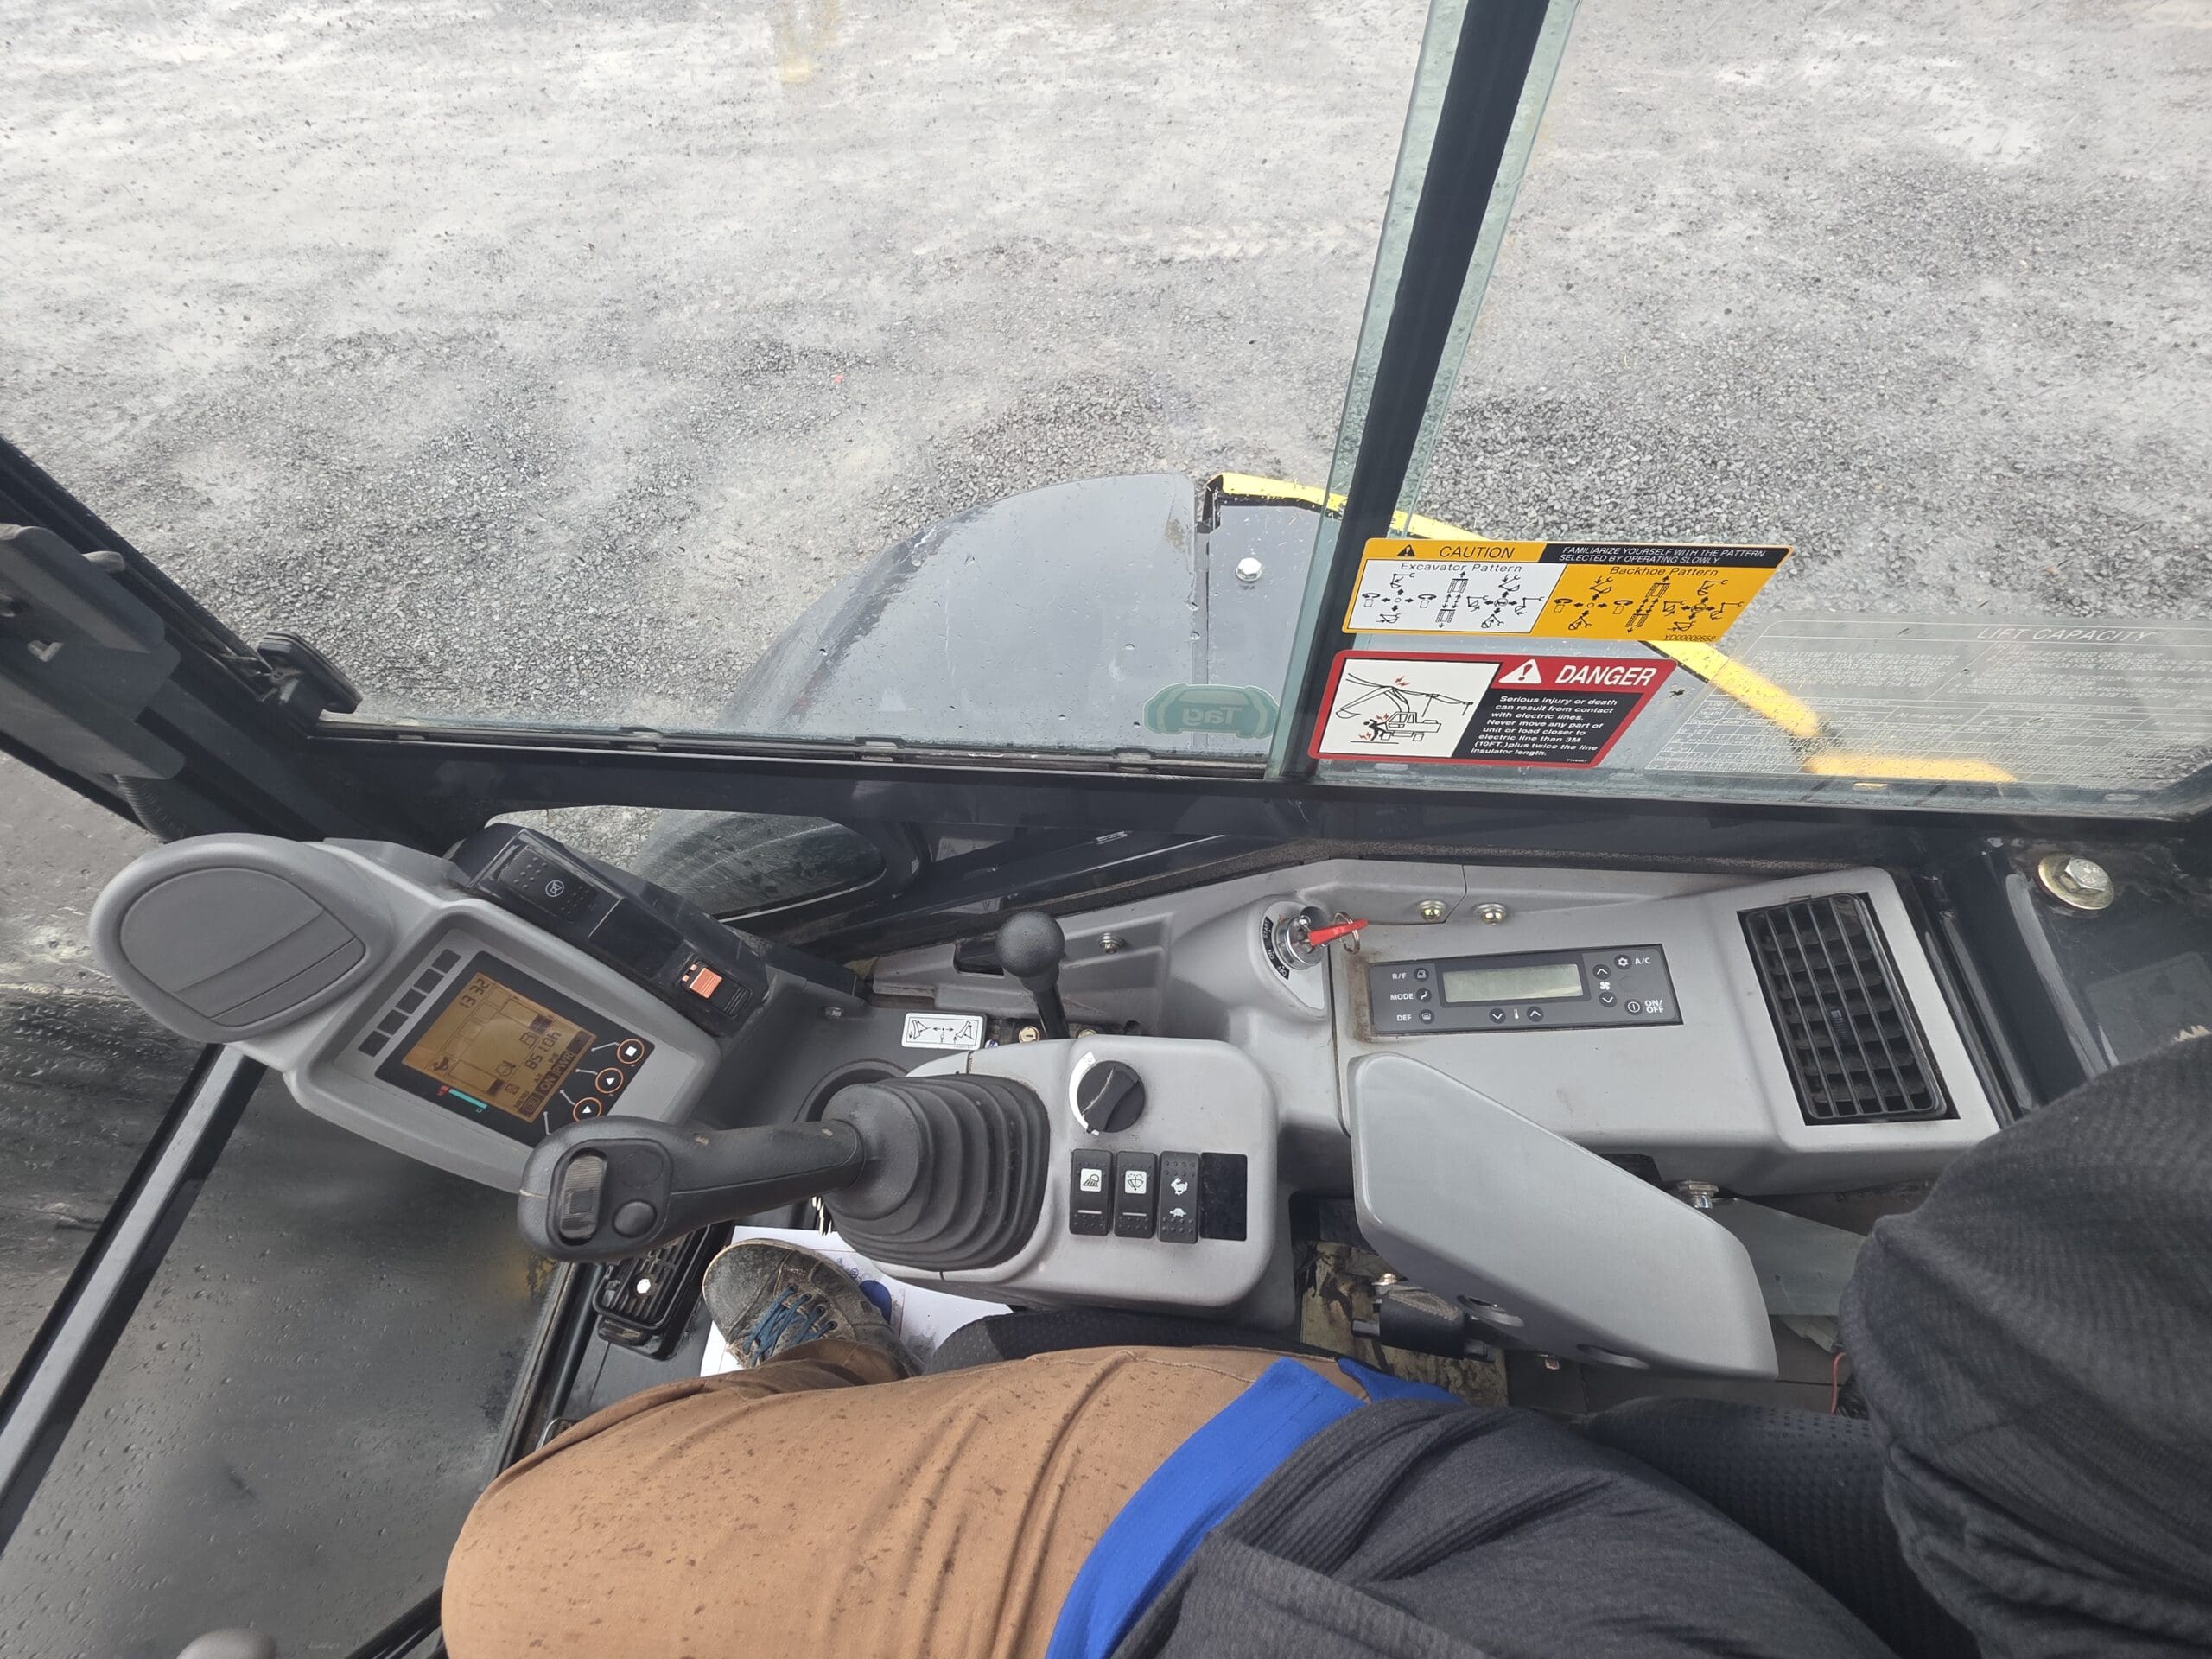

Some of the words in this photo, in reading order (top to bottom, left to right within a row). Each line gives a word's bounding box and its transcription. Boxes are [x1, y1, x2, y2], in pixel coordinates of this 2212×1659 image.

[1440, 546, 1515, 558] CAUTION
[1401, 563, 1466, 571] Excavator
[1472, 563, 1522, 572] Pattern
[1610, 566, 1665, 575] Backhoe
[1669, 568, 1719, 576] Pattern
[1977, 627, 2031, 639] LIFT
[2032, 629, 2158, 642] CAPACITY
[1555, 664, 1656, 685] DANGER
[1542, 696, 1572, 705] injury
[1268, 950, 1274, 959] ON
[554, 1052, 573, 1075] PWR
[540, 1075, 557, 1091] ON
